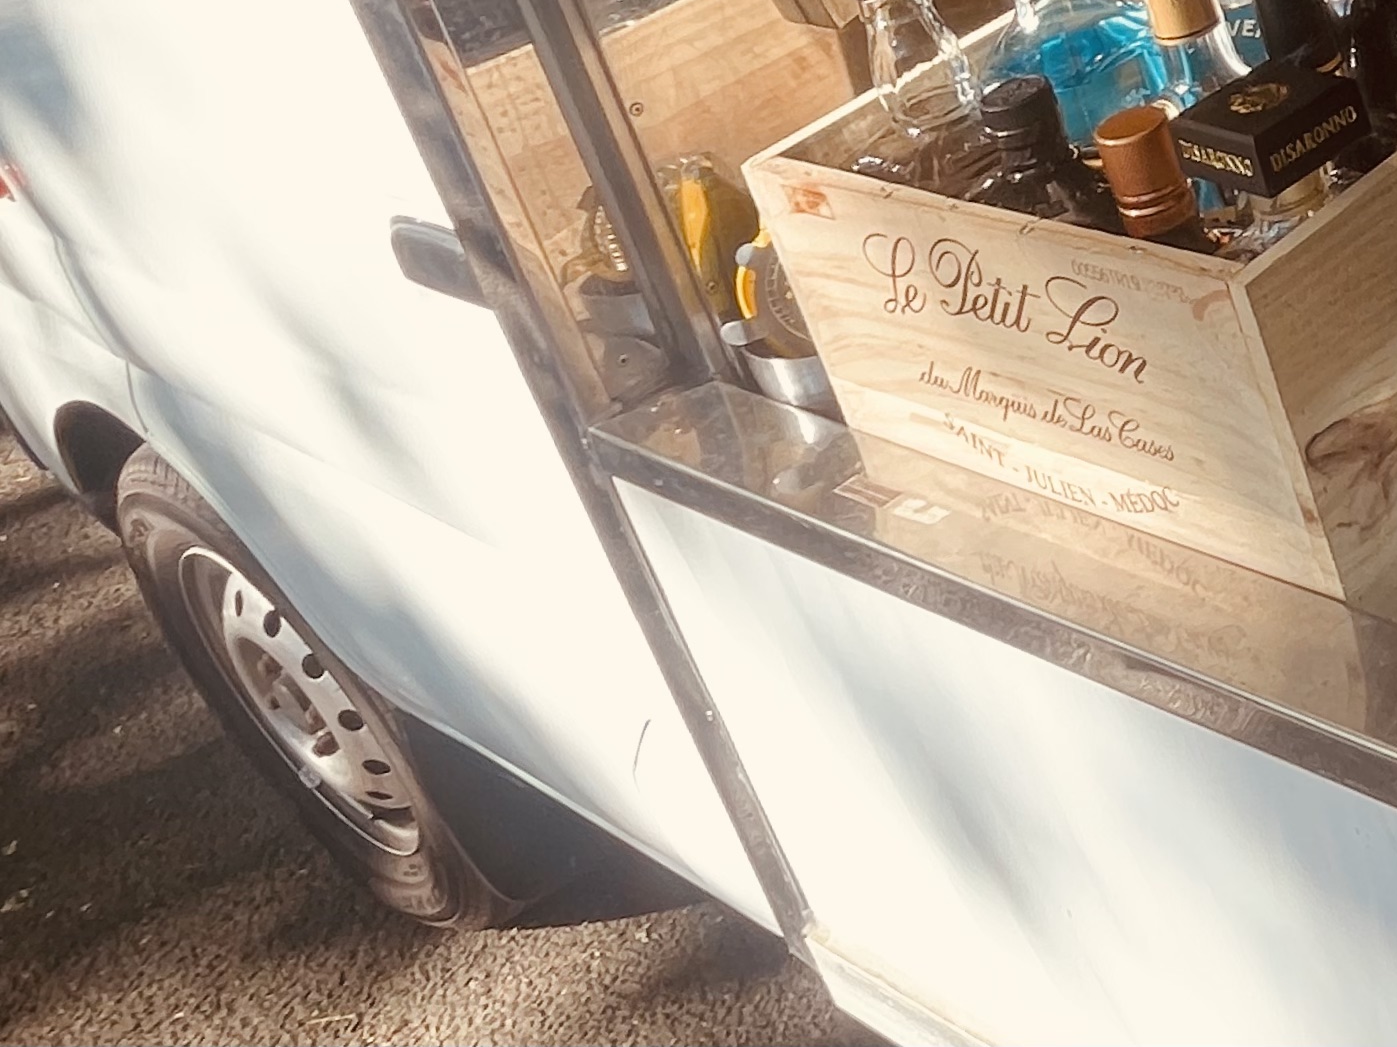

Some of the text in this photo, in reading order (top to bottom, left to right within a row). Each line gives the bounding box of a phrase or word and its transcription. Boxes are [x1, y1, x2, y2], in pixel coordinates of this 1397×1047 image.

[1269, 104, 1358, 173] DISARONNO
[861, 232, 928, 315] Le
[928, 237, 1042, 334] Petit
[1044, 275, 1148, 385] Lion
[918, 360, 950, 390] du
[1062, 395, 1113, 444] Las
[942, 411, 1007, 468] SAINT
[1024, 464, 1097, 507] JULIEN
[1108, 486, 1181, 515] MÉDOC
